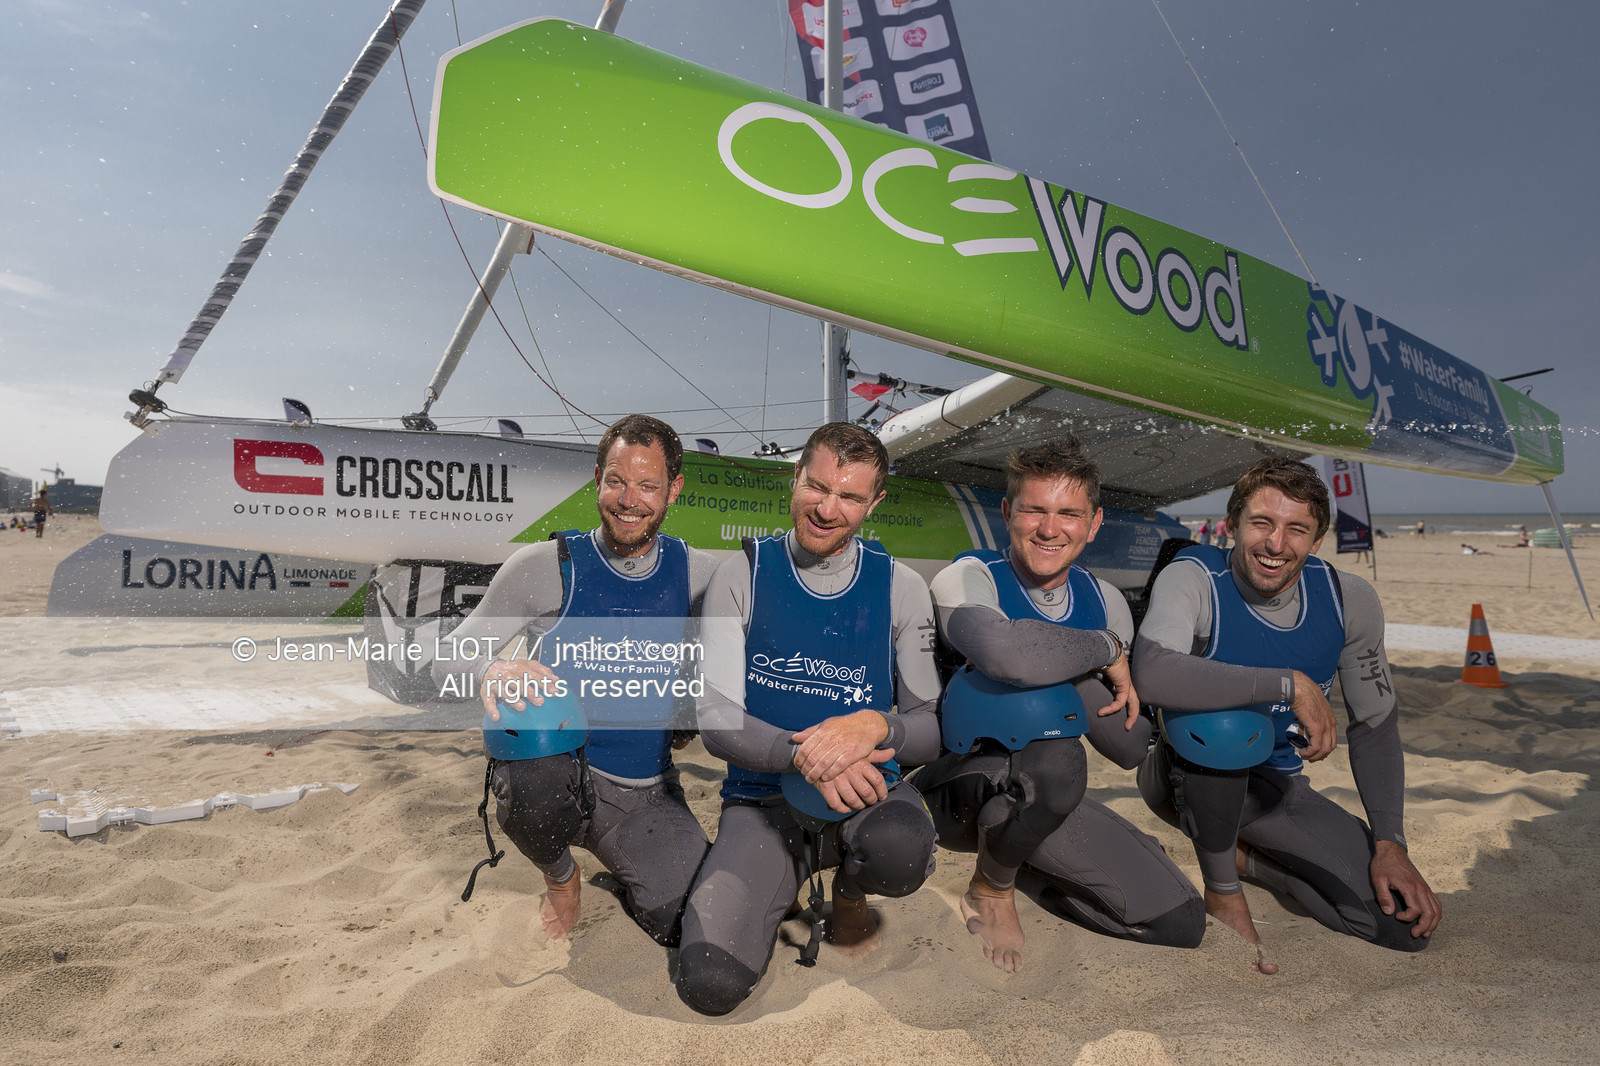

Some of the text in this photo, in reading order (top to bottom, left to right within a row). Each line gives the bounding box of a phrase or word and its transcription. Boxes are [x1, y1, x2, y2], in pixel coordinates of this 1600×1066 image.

[1399, 340, 1490, 414] #WaterFamily
[336, 455, 514, 503] CROSSCALL
[699, 468, 718, 485] La
[724, 471, 783, 492] Solution
[233, 504, 514, 523] OUTDOOR MOBILE TECHNOLOGY
[676, 492, 773, 513] ménagement
[122, 550, 357, 590] LORINA LIMONADE
[574, 660, 671, 676] #WaterFamily
[1470, 651, 1496, 666] 26
[748, 672, 840, 700] #WaterFamily
